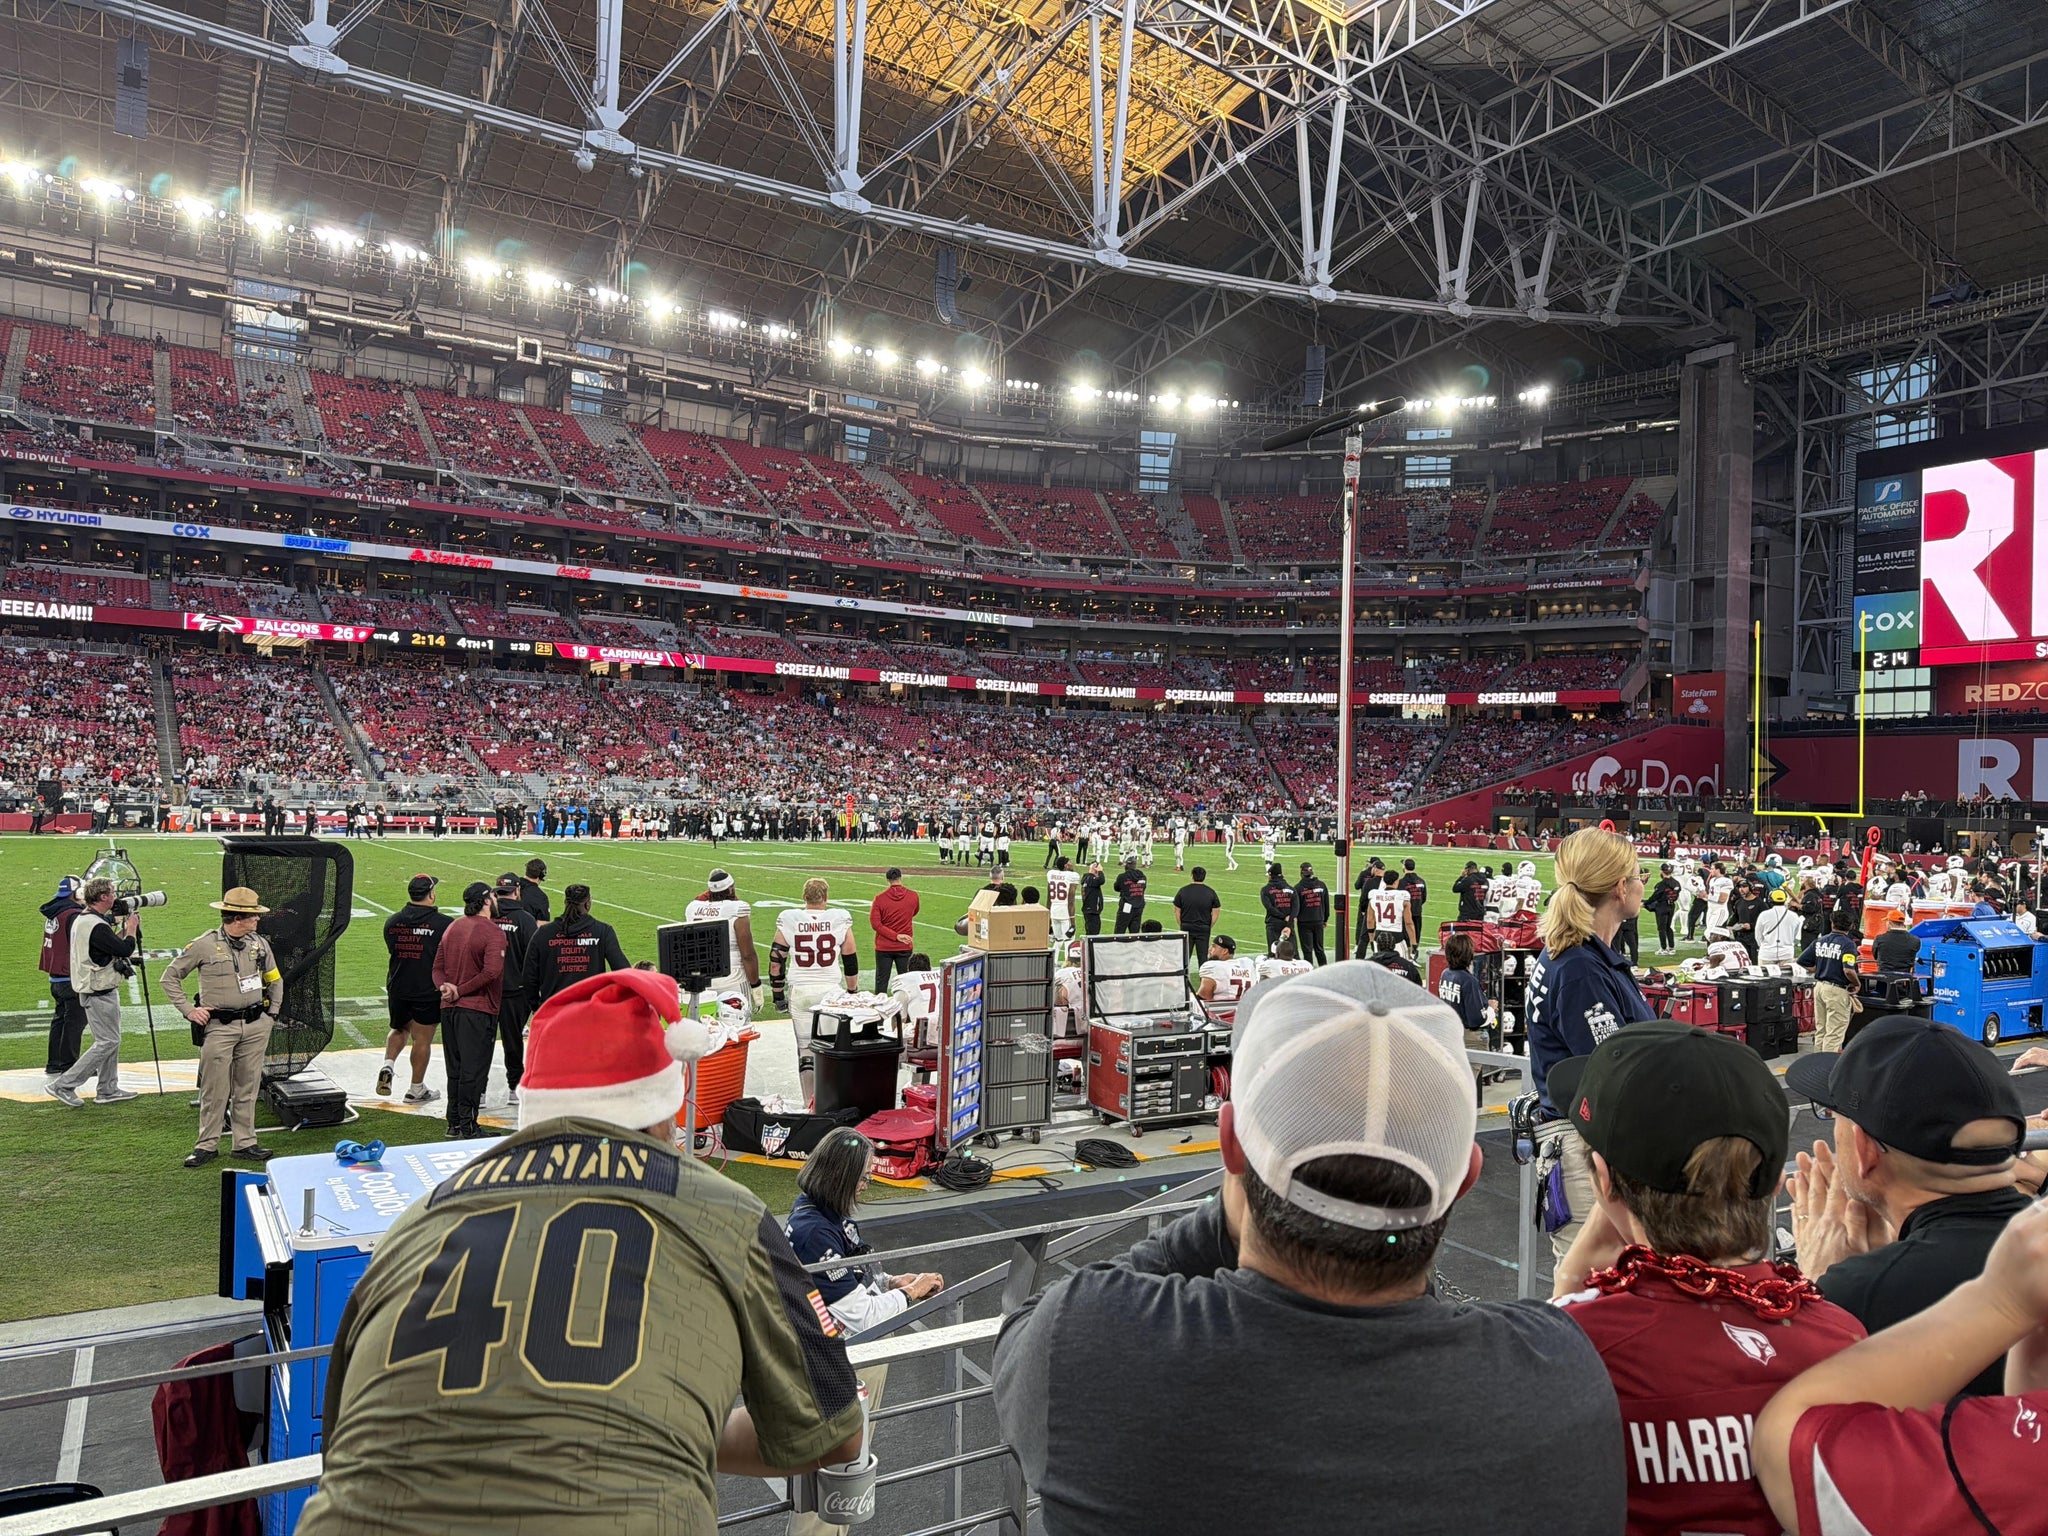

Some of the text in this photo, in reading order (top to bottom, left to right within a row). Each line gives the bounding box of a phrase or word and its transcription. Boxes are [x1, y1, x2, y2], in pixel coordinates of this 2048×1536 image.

[16, 452, 69, 465] BIDWILL
[344, 492, 363, 501] PAT
[366, 494, 409, 507] TILLMAN
[1858, 499, 1919, 515] PACIFIC OFFICE
[1861, 507, 1916, 521] AUTOMATION
[36, 510, 102, 526] HYUNDAI
[173, 523, 210, 539] COX
[766, 546, 792, 556] ROGER
[793, 549, 822, 559] WEHRLI
[1858, 549, 1916, 563] GILA RIVER
[429, 551, 494, 569] State Farm
[930, 568, 961, 578] CHARLEY
[962, 572, 983, 580] TRIPPI
[1526, 580, 1602, 591] JIMMY CONZELMAN
[0, 599, 94, 622] EEEAAM!!!
[966, 611, 1008, 625] AVNET
[1858, 610, 1915, 633] COX
[255, 620, 354, 639] FALCONS 26
[388, 631, 400, 644] 4
[411, 633, 446, 647] 2:14
[518, 642, 531, 652] 39
[537, 643, 551, 654] 25
[572, 645, 664, 662] 19 CARDINALS
[2035, 642, 2048, 658] S
[1872, 651, 1909, 668] 2:14
[1681, 688, 1718, 698] State Farm
[1841, 840, 1851, 857] 4
[694, 907, 720, 918] JACOBS
[1375, 902, 1397, 923] 14
[798, 921, 831, 934] CONNER
[561, 946, 587, 955] EQUITY
[793, 934, 836, 968] 58
[557, 955, 590, 963] FREEDOM
[1732, 950, 1752, 970] 18
[559, 964, 588, 973] JUSTICE
[1231, 967, 1250, 978] ADAMS
[919, 982, 941, 1015] 7
[1933, 987, 1960, 998] opilot
[453, 1142, 649, 1191] TILLMAN
[356, 1171, 413, 1217] Copilot
[384, 1198, 659, 1396] 40
